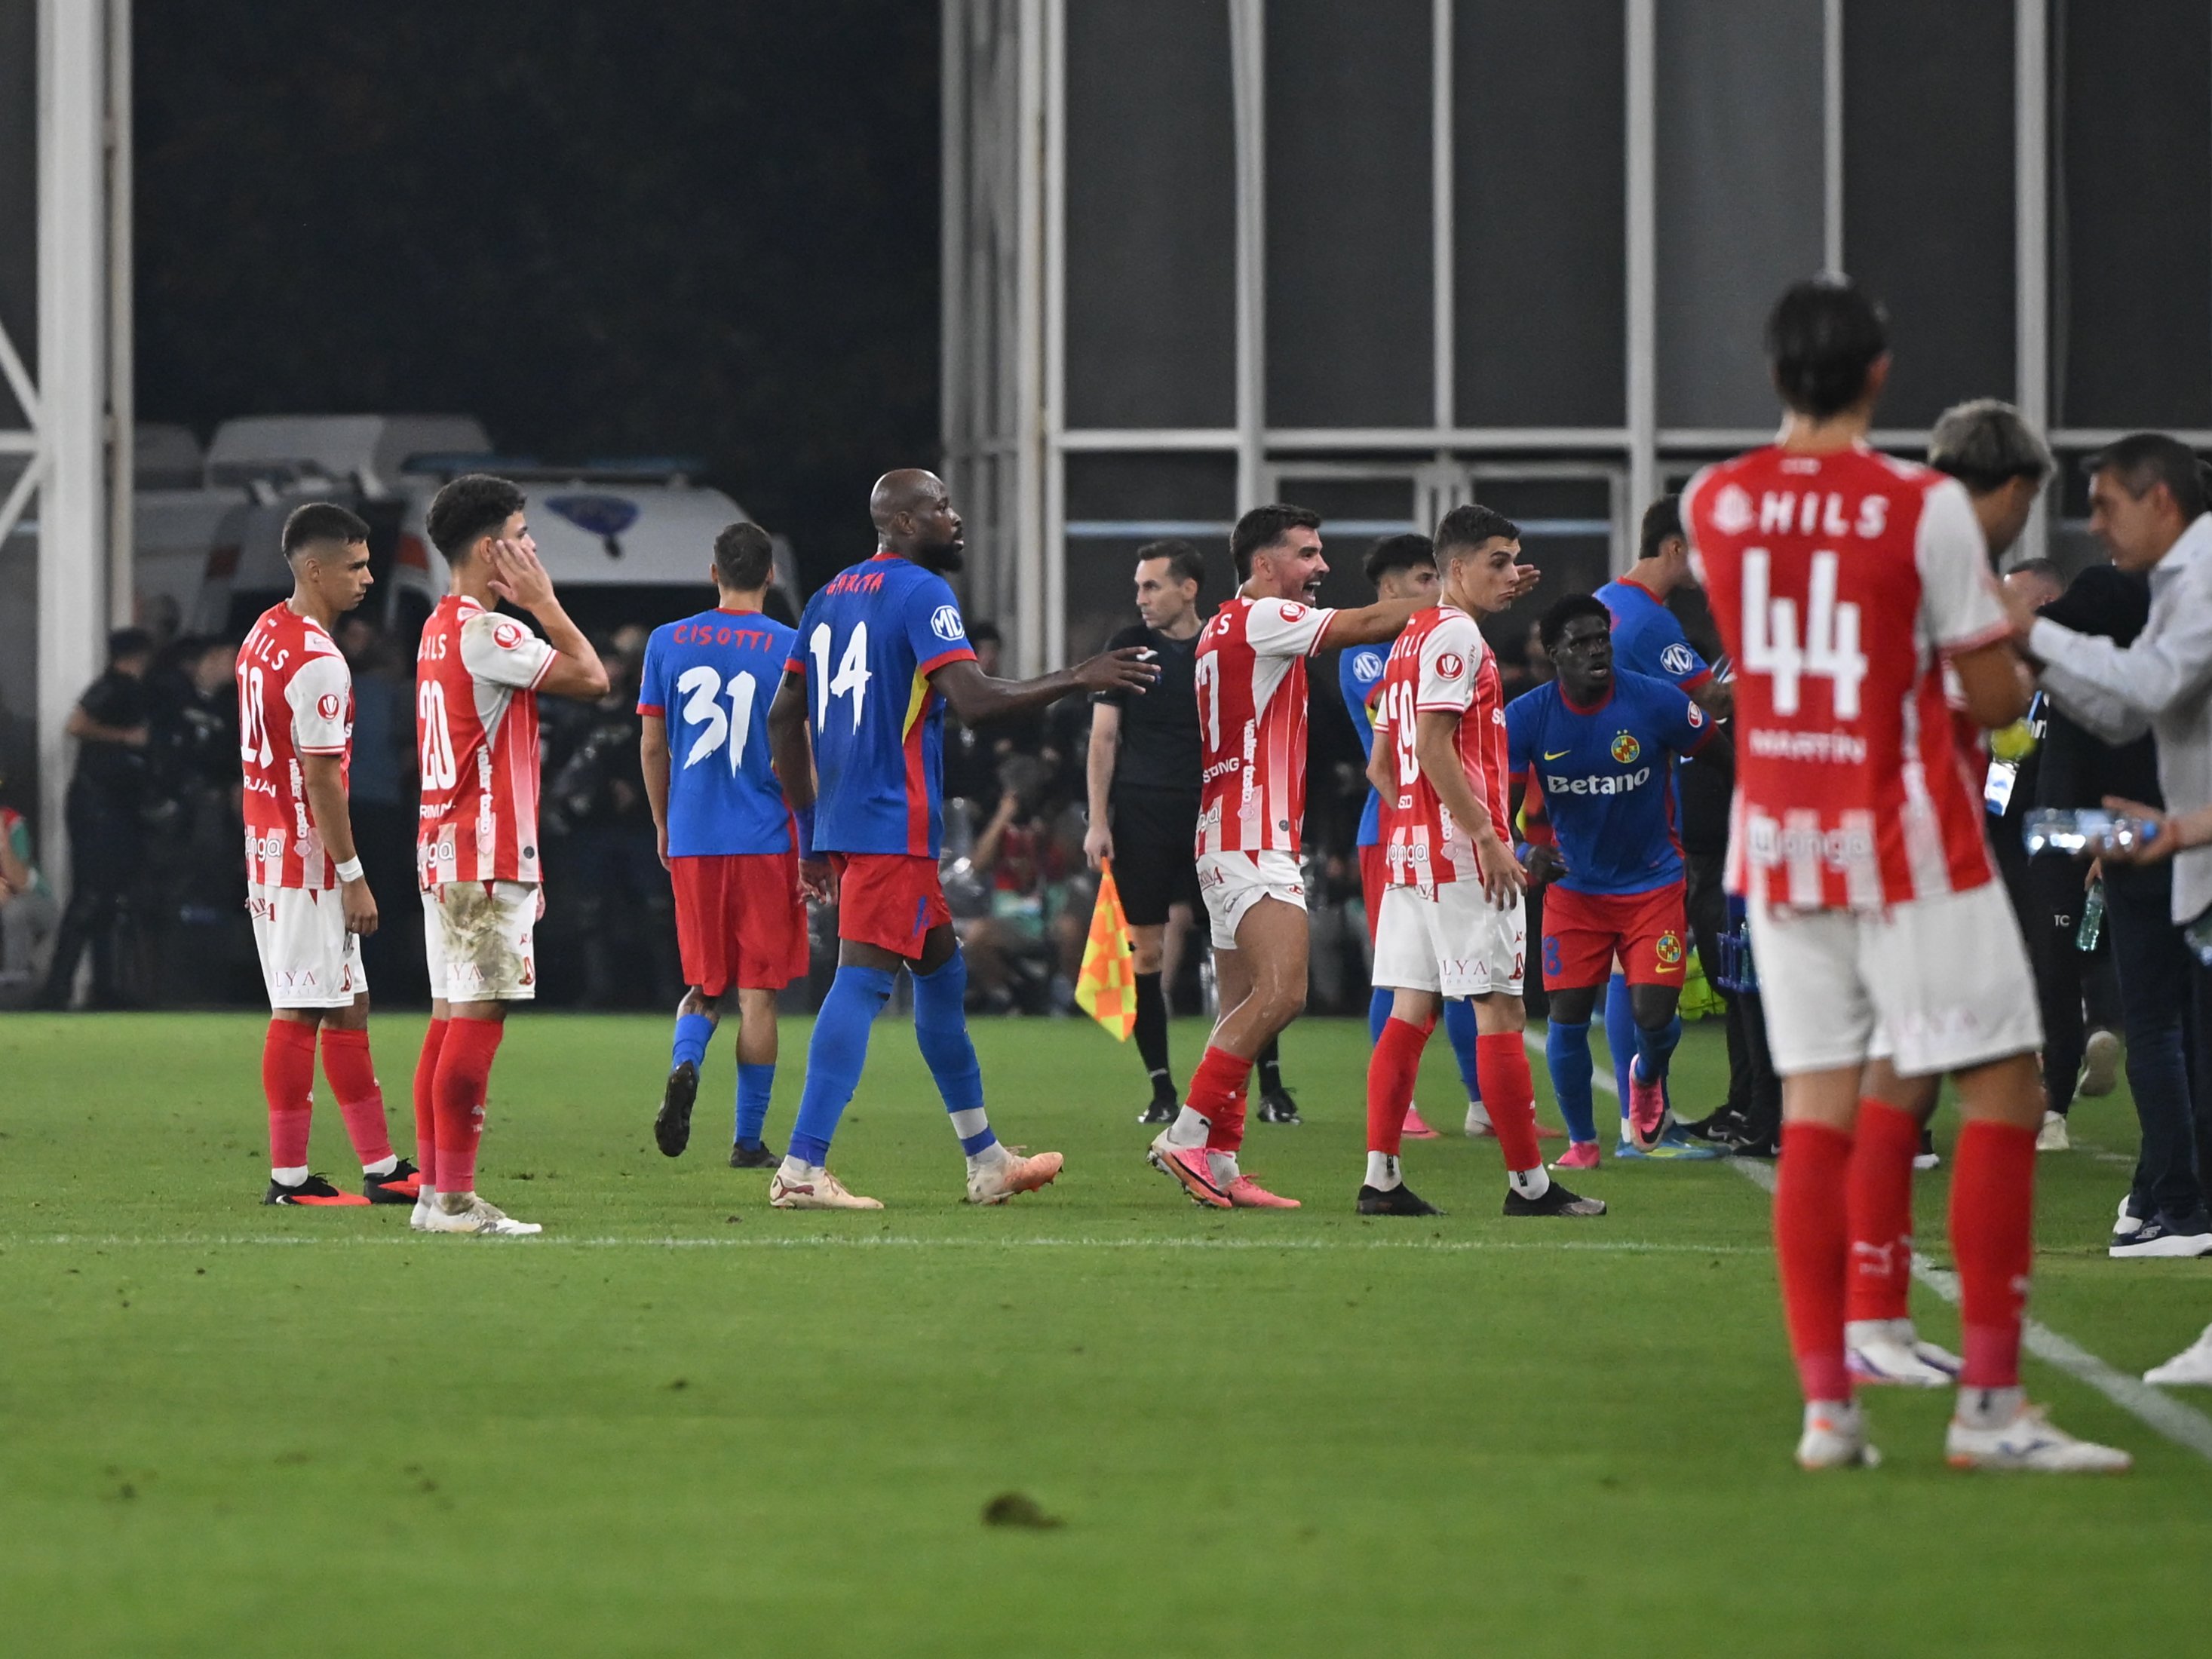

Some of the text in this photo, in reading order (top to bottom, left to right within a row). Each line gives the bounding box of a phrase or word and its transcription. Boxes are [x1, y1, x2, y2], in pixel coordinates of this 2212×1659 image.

[673, 624, 773, 652] CISOTTI
[809, 621, 873, 737] 14
[1741, 546, 1869, 721] 44
[419, 679, 457, 790] 20
[676, 666, 756, 779] 31
[1195, 649, 1220, 753] 7
[1547, 766, 1650, 795] Betano
[2054, 915, 2070, 927] TC
